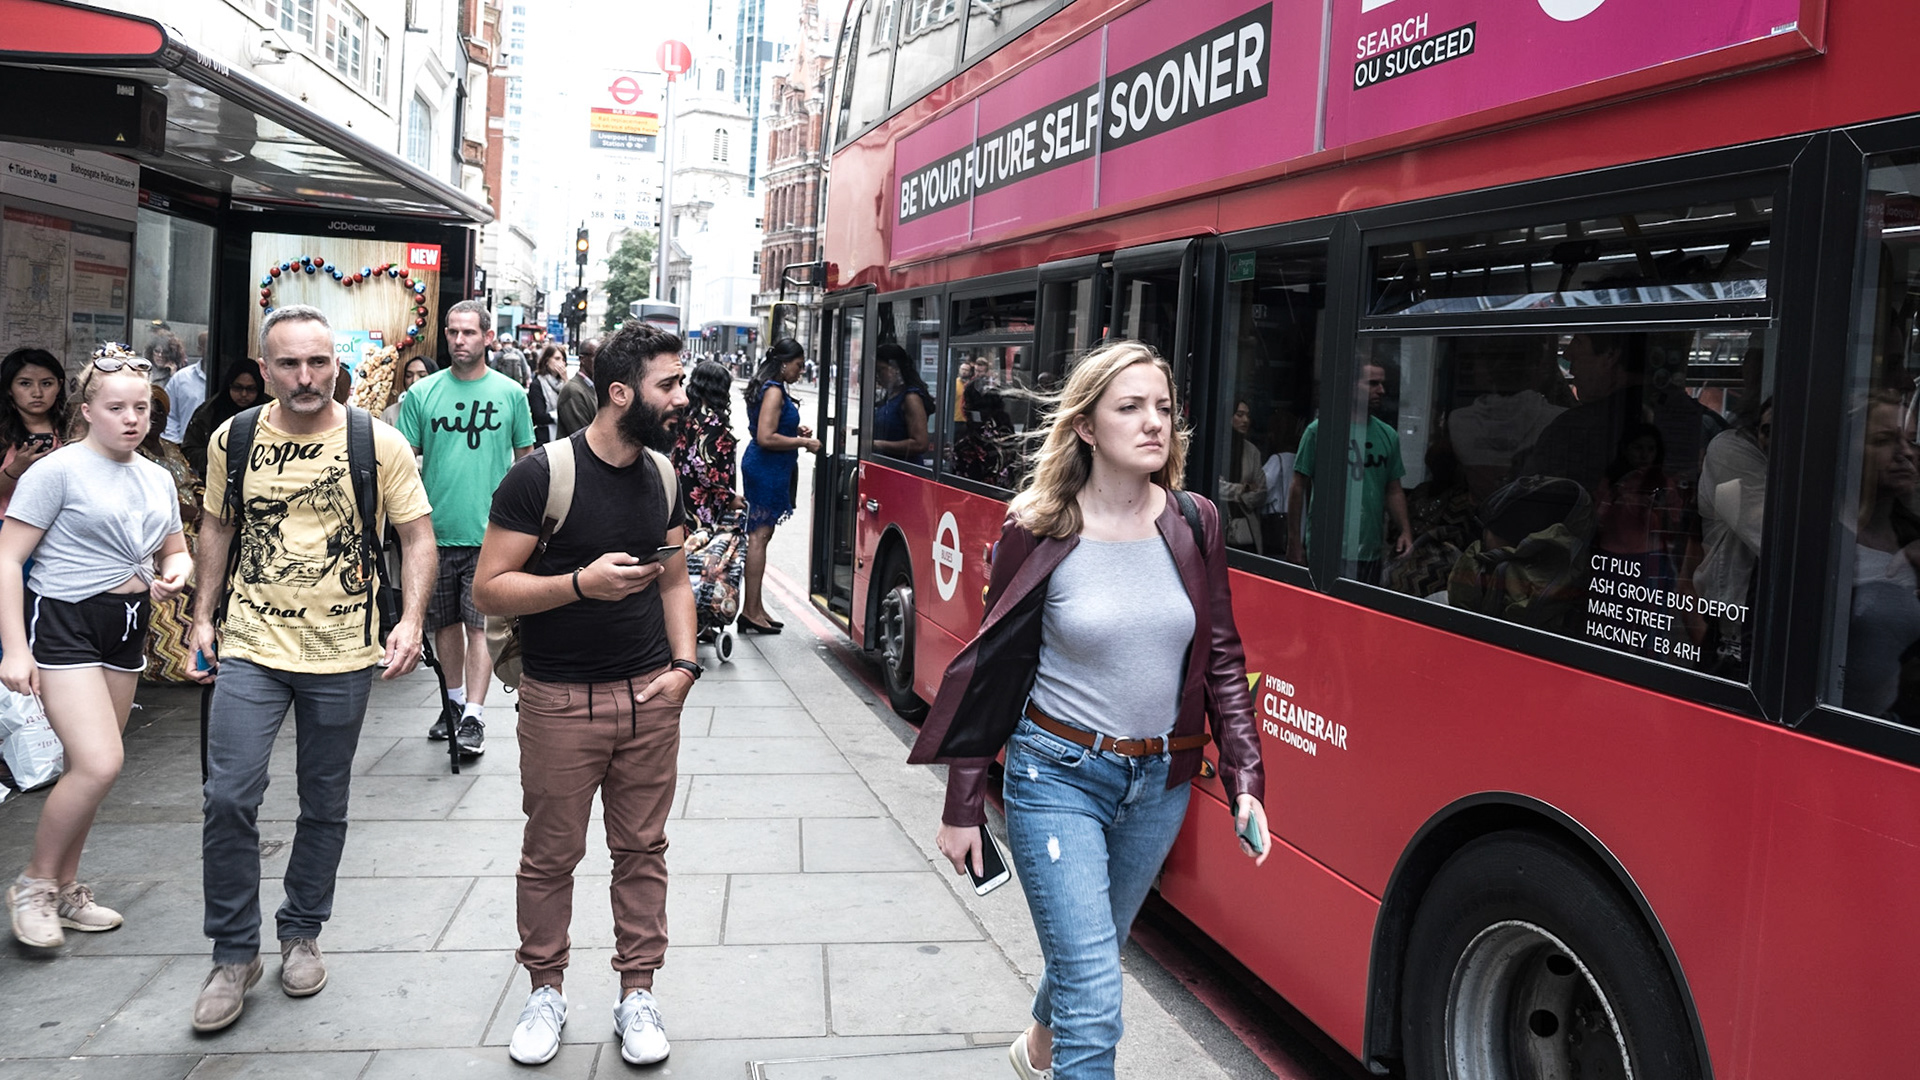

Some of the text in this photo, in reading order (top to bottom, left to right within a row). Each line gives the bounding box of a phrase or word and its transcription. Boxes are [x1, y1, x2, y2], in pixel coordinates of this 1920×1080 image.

[1356, 12, 1428, 59] SEARCH
[665, 44, 682, 71] L
[1355, 27, 1474, 87] OU SUCCEED
[900, 22, 1265, 219] BE YOUR FUTURE SELF SOONER
[598, 132, 648, 143] Liverpool Street
[15, 164, 47, 182] Ticket Shop
[100, 171, 114, 184] Police
[327, 221, 376, 232] JCDecaux
[613, 212, 626, 220] N8
[410, 248, 439, 266] NEW
[431, 400, 502, 450] nift
[1591, 554, 1641, 578] CT PLUS
[1588, 577, 1749, 623] ASH GROVE BUS DEPOT
[1587, 598, 1674, 631] MARE STREET
[1586, 620, 1701, 662] HACKNEY E8 4RH
[1265, 674, 1295, 697] HYBRID
[1263, 719, 1317, 757] FOR LONDON
